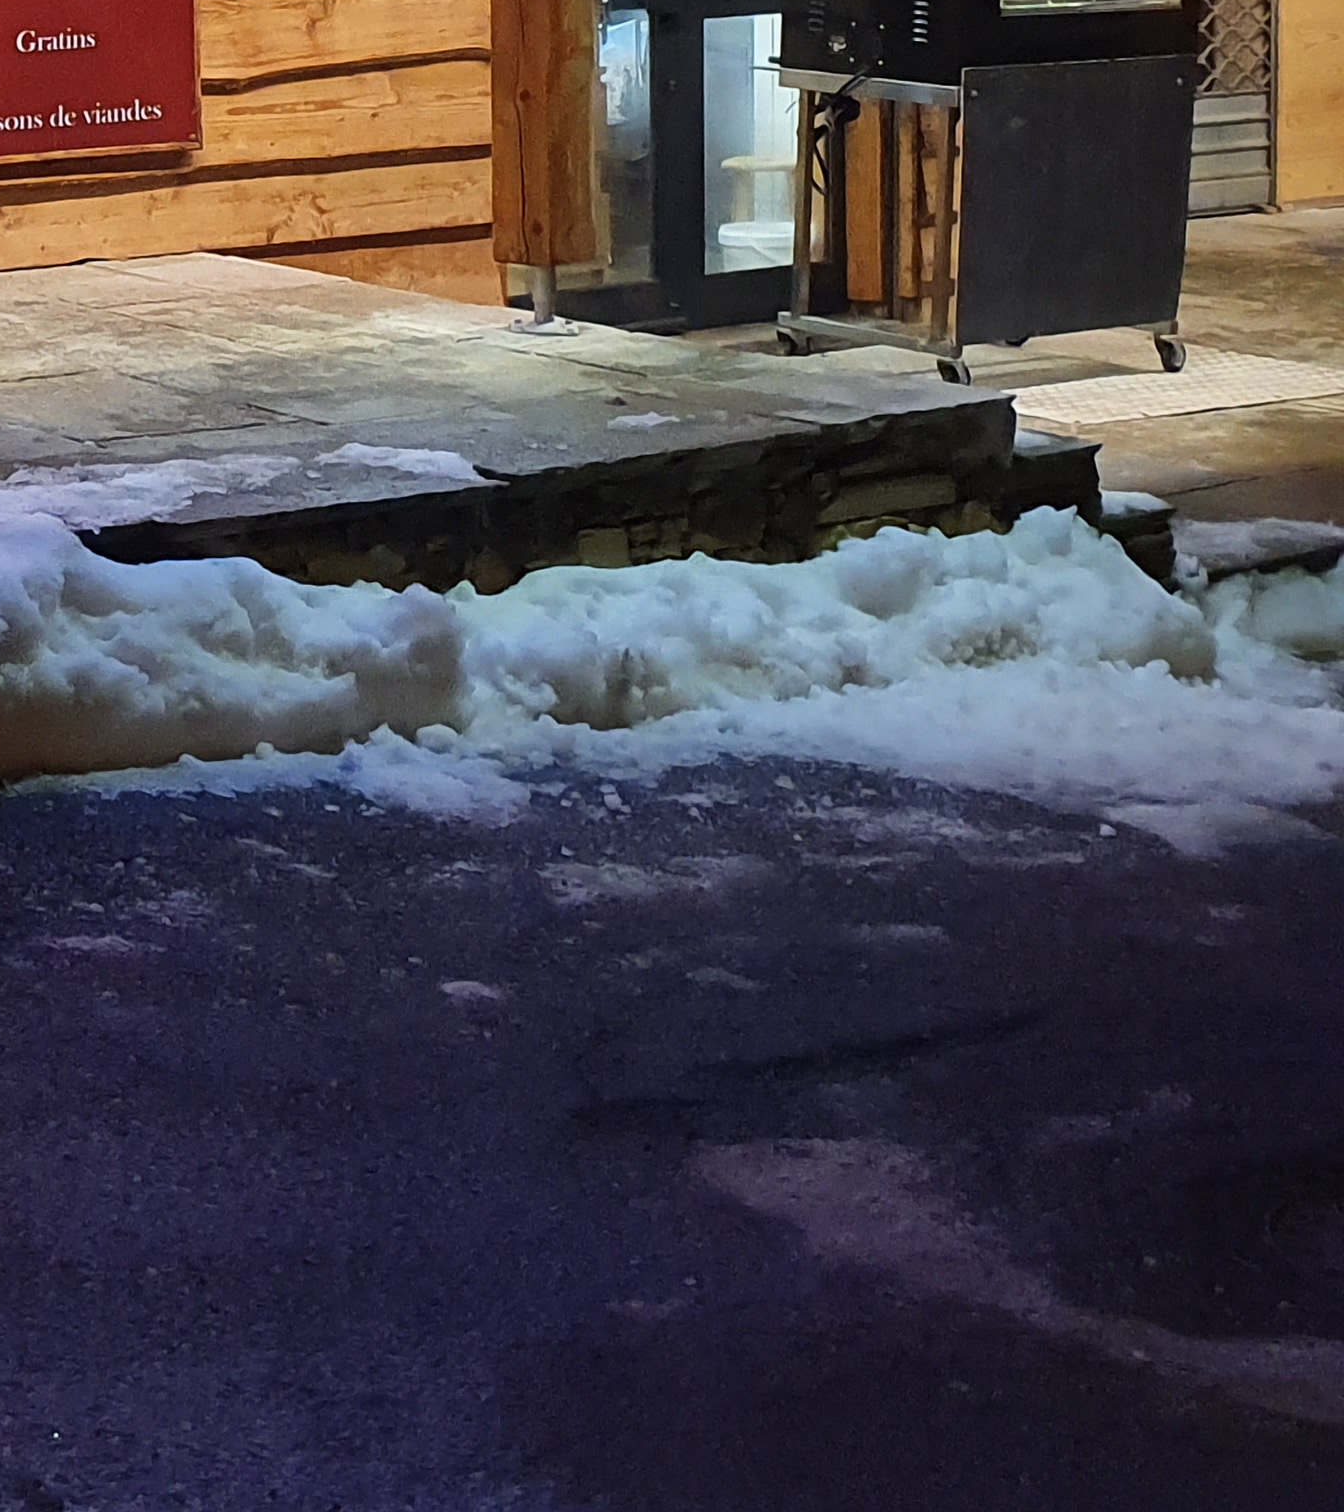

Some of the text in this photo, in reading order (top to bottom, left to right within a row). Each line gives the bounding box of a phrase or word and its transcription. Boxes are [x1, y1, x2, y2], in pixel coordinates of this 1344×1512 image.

[15, 27, 97, 53] Gratins
[49, 104, 78, 128] de
[83, 98, 163, 124] viandes
